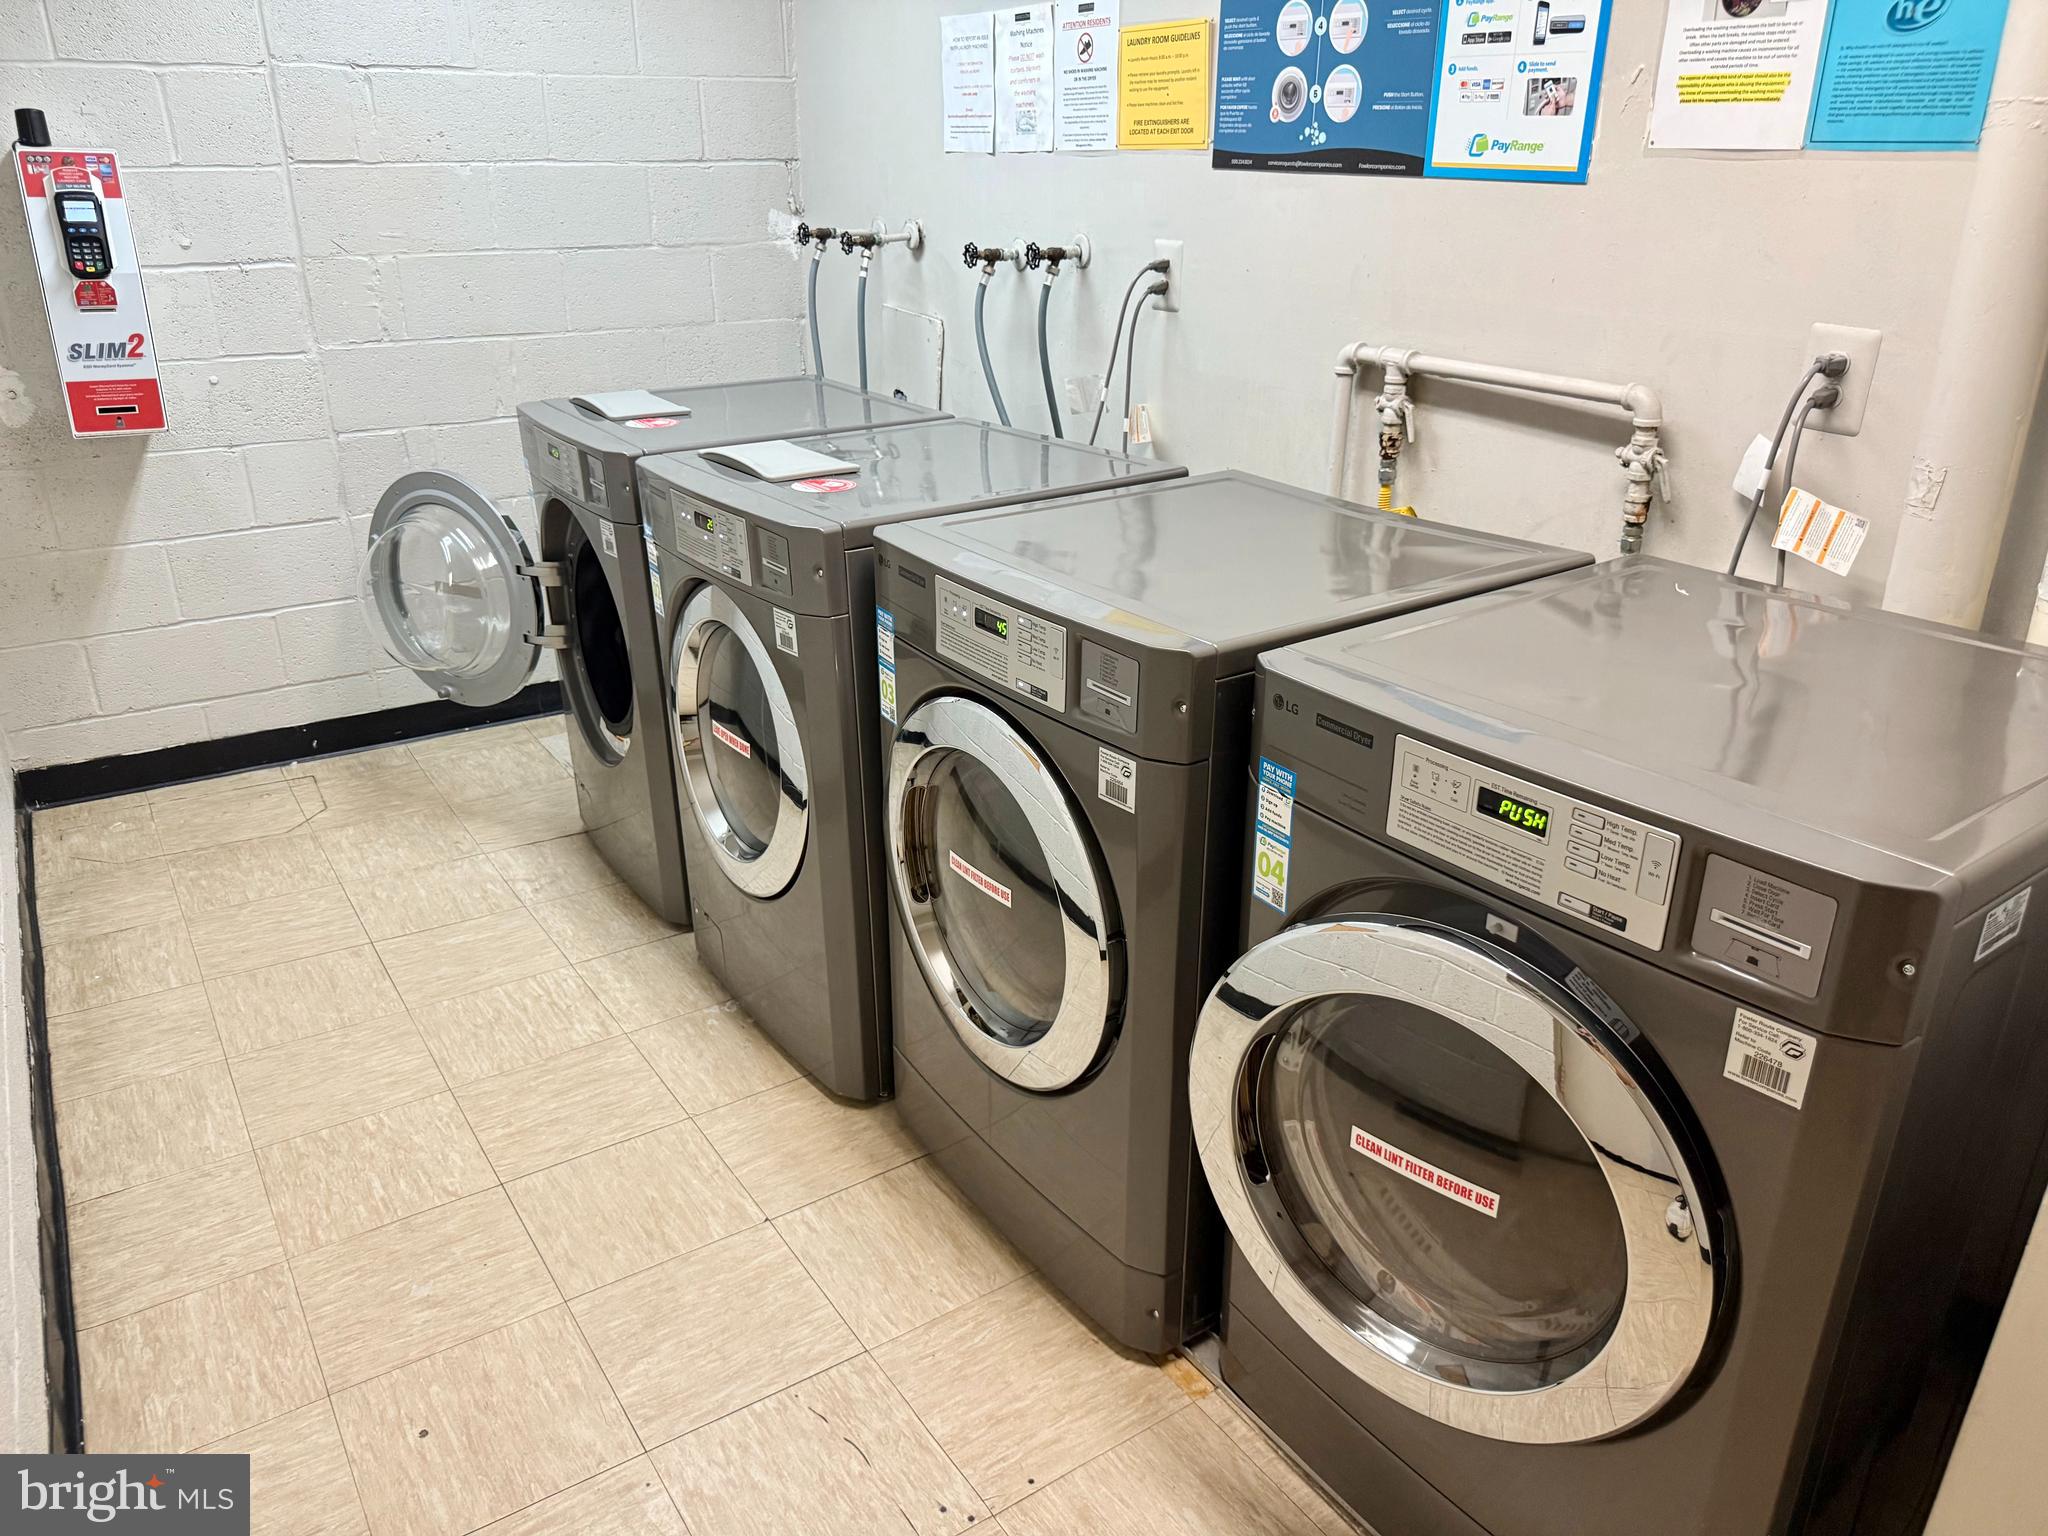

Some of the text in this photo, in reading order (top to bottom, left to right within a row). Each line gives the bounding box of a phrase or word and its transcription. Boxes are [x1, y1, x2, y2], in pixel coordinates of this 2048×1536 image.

[1062, 17, 1111, 29] ATTENTION RESIDENTS
[1318, 21, 1323, 30] 4
[1481, 13, 1513, 23] PayRange
[1127, 31, 1201, 46] LAUNDRY ROOM GUIDELINES
[1313, 90, 1318, 98] 5
[1144, 118, 1179, 126] EXTINGUISHERS
[1180, 117, 1190, 125] ARE
[1129, 128, 1150, 136] LOCATED
[1170, 127, 1180, 135] EXIT
[1181, 127, 1194, 135] DOOR
[1491, 139, 1544, 154] PayRange
[68, 333, 145, 361] SLIM2
[881, 679, 895, 705] 03
[1286, 701, 1299, 716] LG
[1317, 716, 1373, 748] Commercial Dryer
[1263, 762, 1293, 782] PAY WITH
[1263, 769, 1292, 788] YOUR PHONE
[1266, 790, 1283, 802] Download
[1499, 800, 1547, 830] PUSH
[1606, 820, 1620, 831] High
[1604, 836, 1617, 846] Med
[1600, 853, 1614, 862] Low
[1258, 851, 1284, 887] 04
[1598, 870, 1621, 883] No Heat
[1738, 1018, 1748, 1026] For
[1748, 1023, 1768, 1034] Service
[1775, 1027, 1803, 1042] Company
[1734, 1037, 1772, 1056] Machine Code
[1355, 1133, 1496, 1211] CLEAN LINT FILTER BEFORE USE
